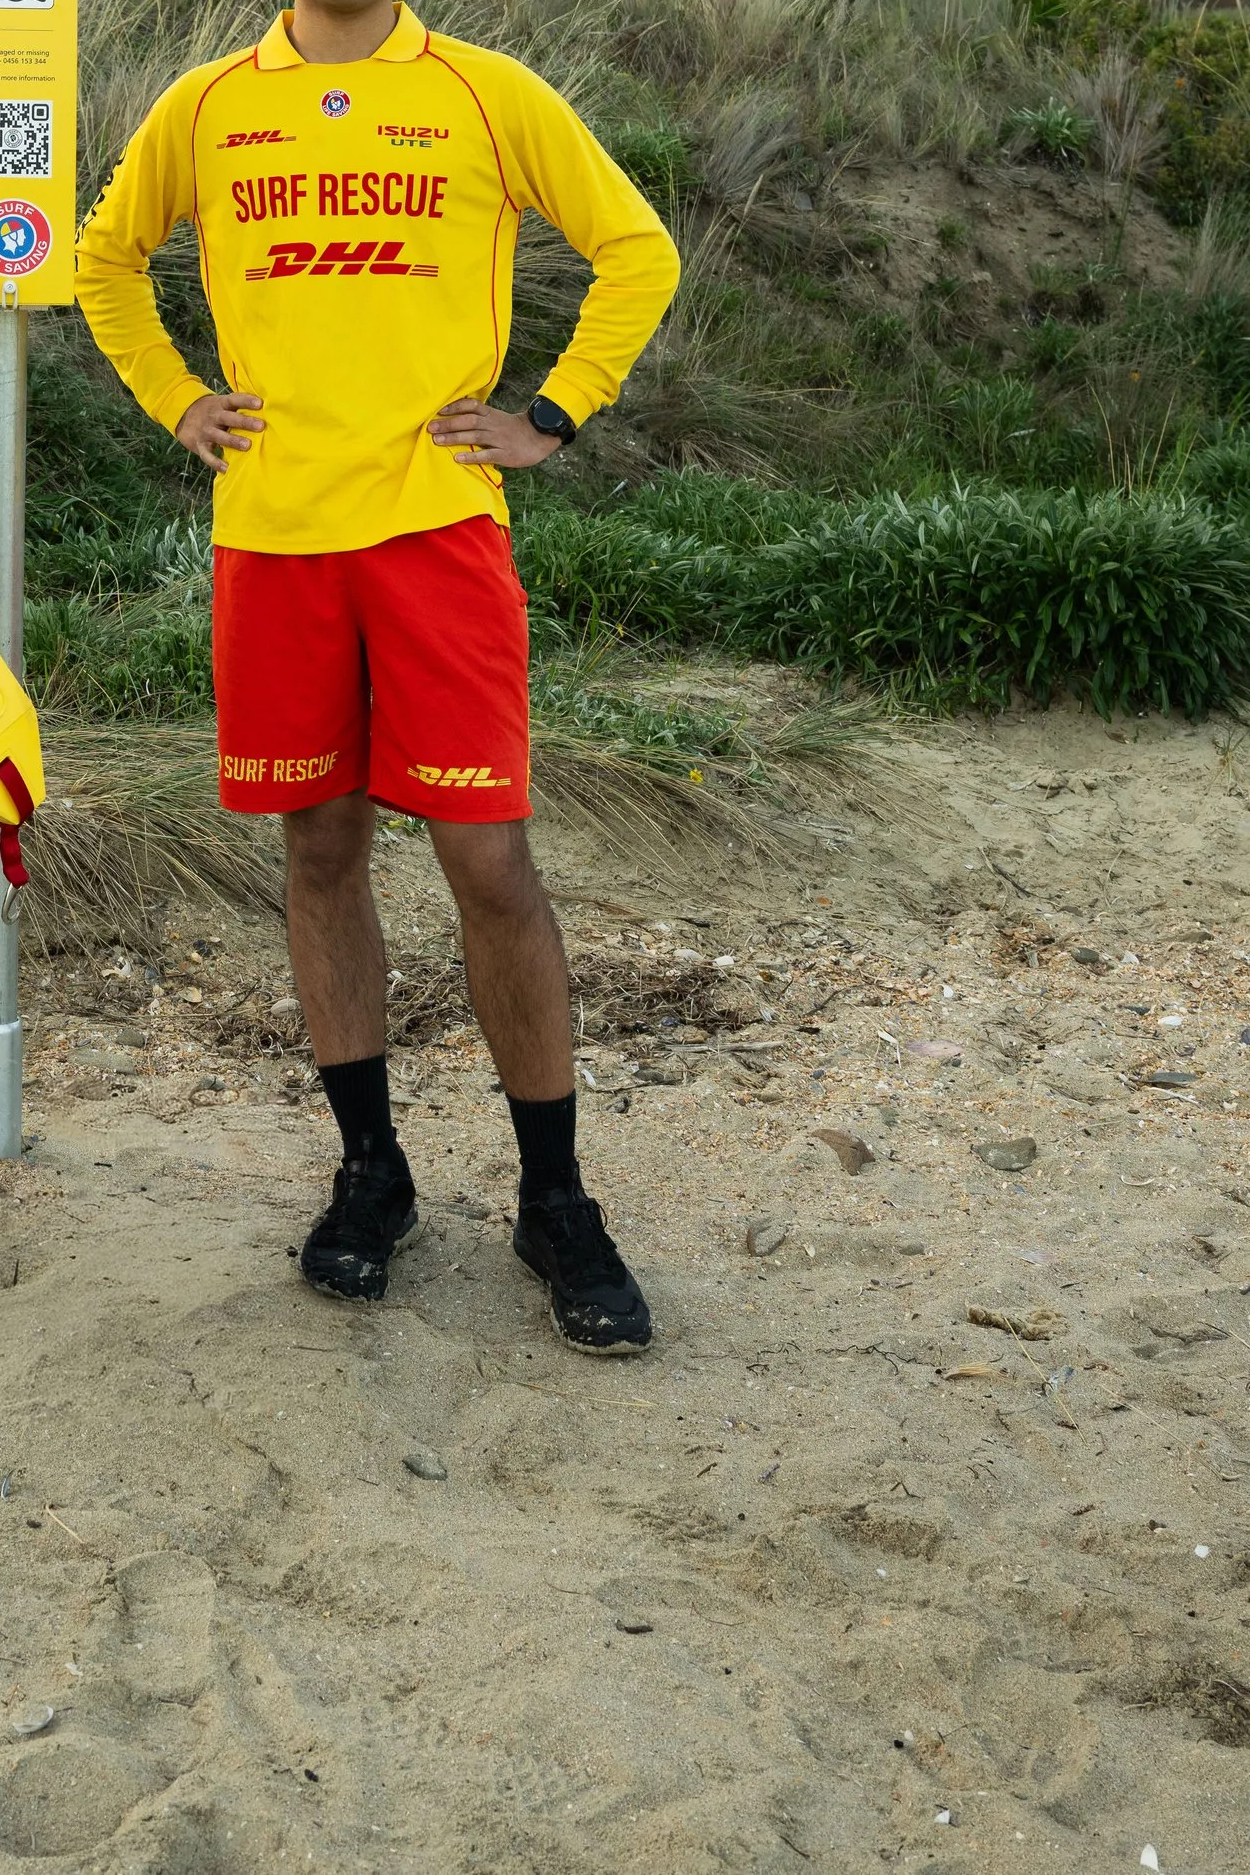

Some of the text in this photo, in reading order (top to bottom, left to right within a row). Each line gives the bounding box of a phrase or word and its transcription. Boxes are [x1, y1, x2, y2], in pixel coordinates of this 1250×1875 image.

[26, 49, 50, 57] missing
[18, 74, 56, 82] information
[225, 129, 287, 148] DHL
[377, 125, 449, 139] ISUZU
[391, 138, 433, 148] UTE
[232, 172, 448, 223] SURF RESCUE
[4, 240, 48, 273] SAVING
[266, 241, 413, 279] DHL
[224, 750, 339, 783] SURF RESCUE
[415, 763, 502, 788] DHL
